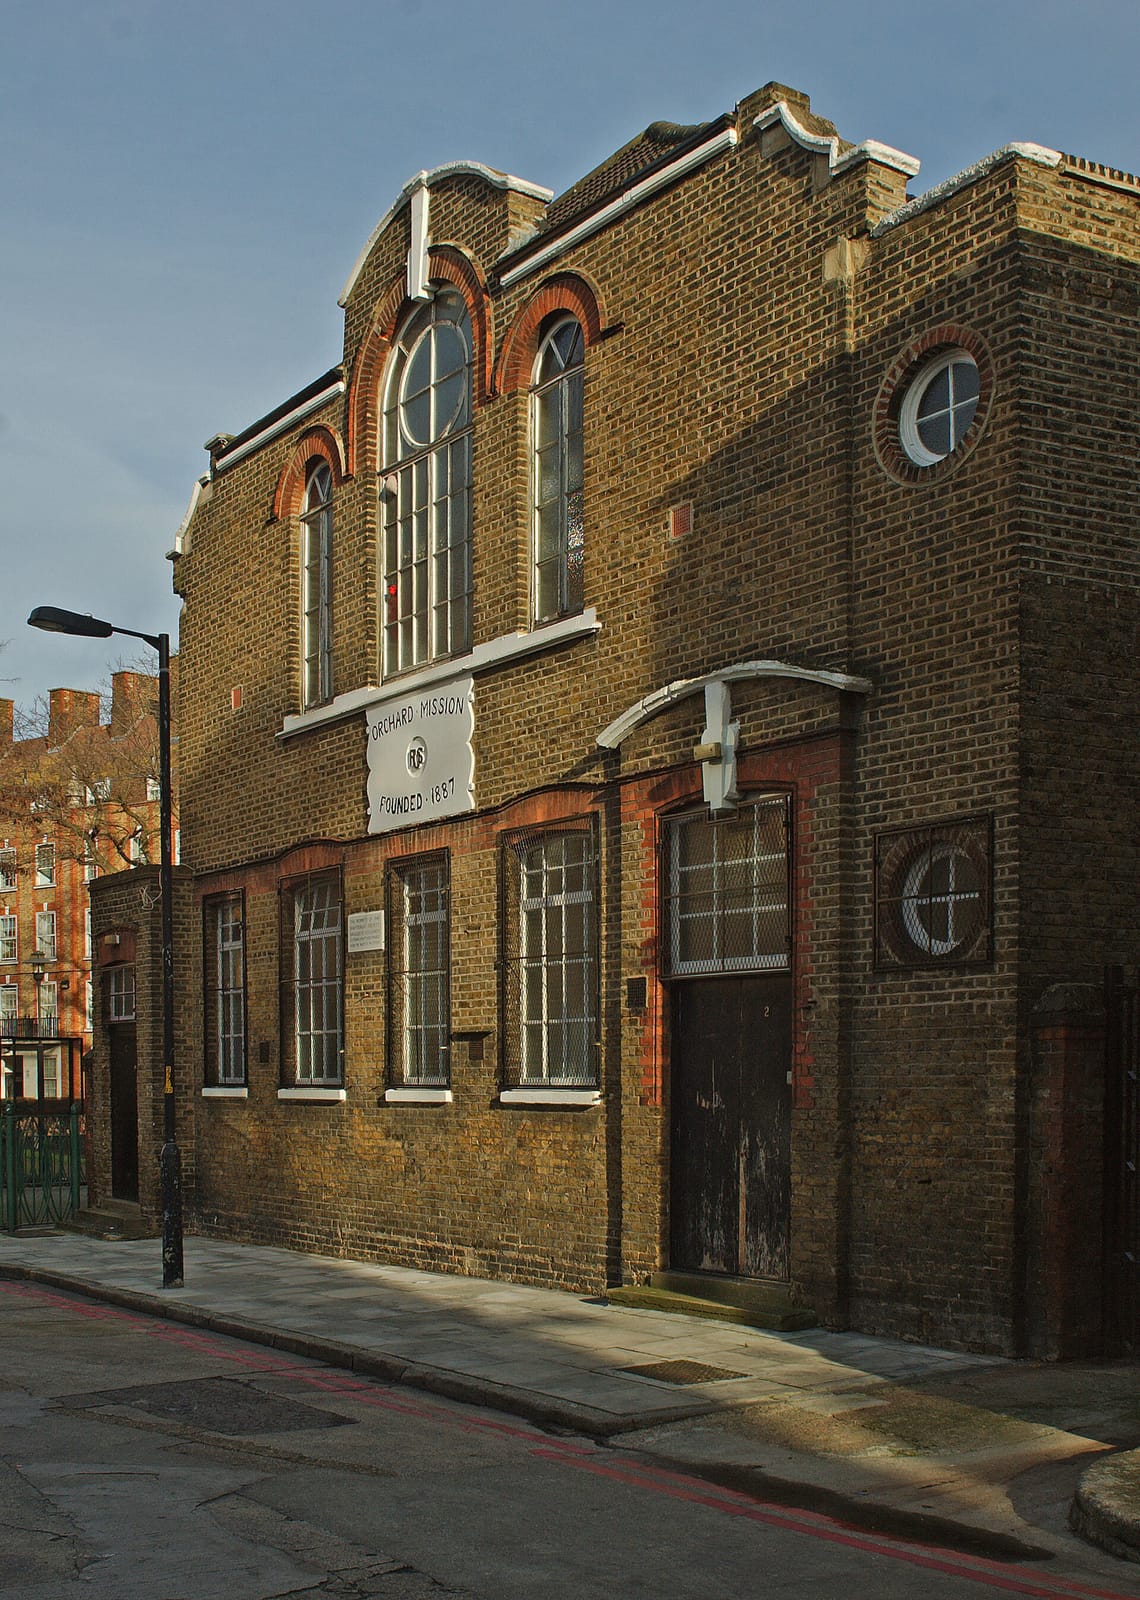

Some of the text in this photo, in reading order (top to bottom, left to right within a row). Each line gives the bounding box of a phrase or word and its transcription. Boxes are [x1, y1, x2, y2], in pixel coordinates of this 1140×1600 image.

[371, 697, 464, 741] ORCHARD MISSION
[379, 776, 455, 815] FOUNDED 1887
[764, 1006, 770, 1018] 2
